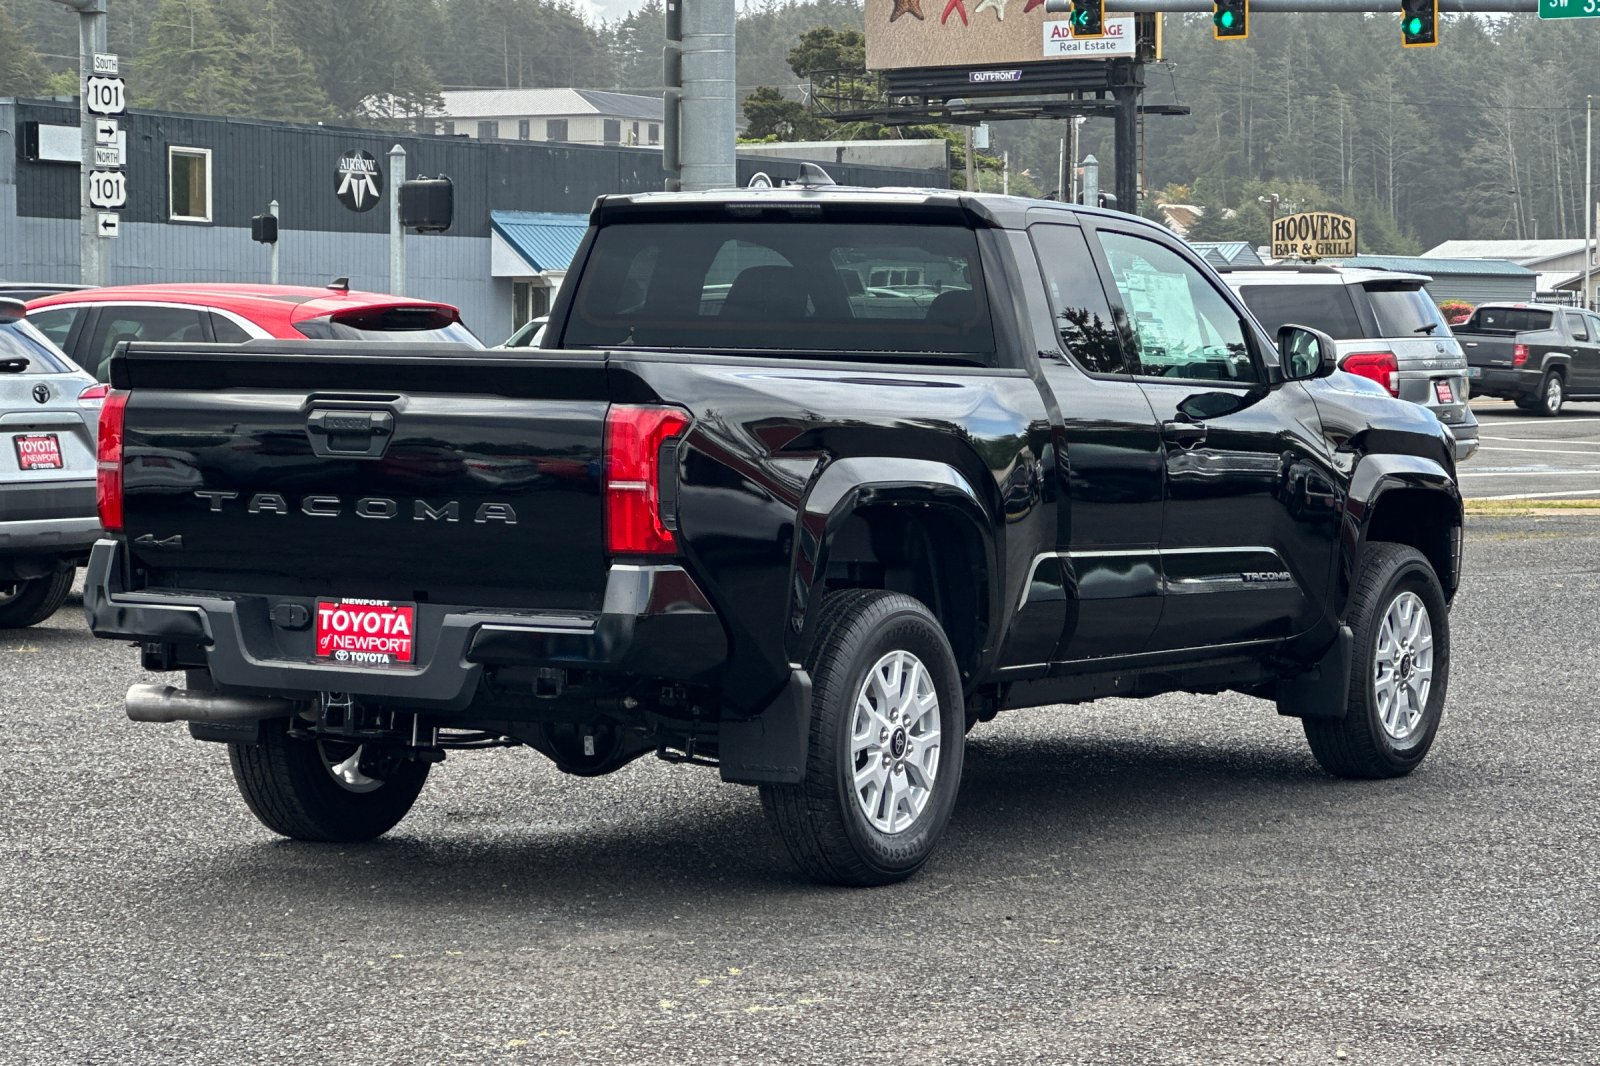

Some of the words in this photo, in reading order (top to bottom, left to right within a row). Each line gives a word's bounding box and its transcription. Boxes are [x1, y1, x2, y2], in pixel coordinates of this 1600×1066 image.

[1060, 41, 1081, 51] Real
[1084, 41, 1116, 51] Estate
[95, 57, 117, 70] SOUTH
[973, 71, 1016, 81] OUTFRONT
[94, 85, 119, 106] 101
[96, 150, 118, 163] NORTH
[95, 179, 120, 199] 101
[1275, 215, 1352, 241] HOOVERS
[1275, 243, 1298, 256] BAR
[1302, 243, 1312, 256] &
[1316, 242, 1353, 255] GRILL
[18, 440, 58, 453] TOYOTA
[194, 490, 518, 524] TACOMA
[1242, 571, 1291, 581] TACOMA
[341, 597, 390, 607] NEWPORT
[318, 609, 410, 635] TOYOTA
[320, 633, 333, 649] of
[333, 634, 411, 652] NEWPORT
[350, 652, 390, 664] TOYOTA
